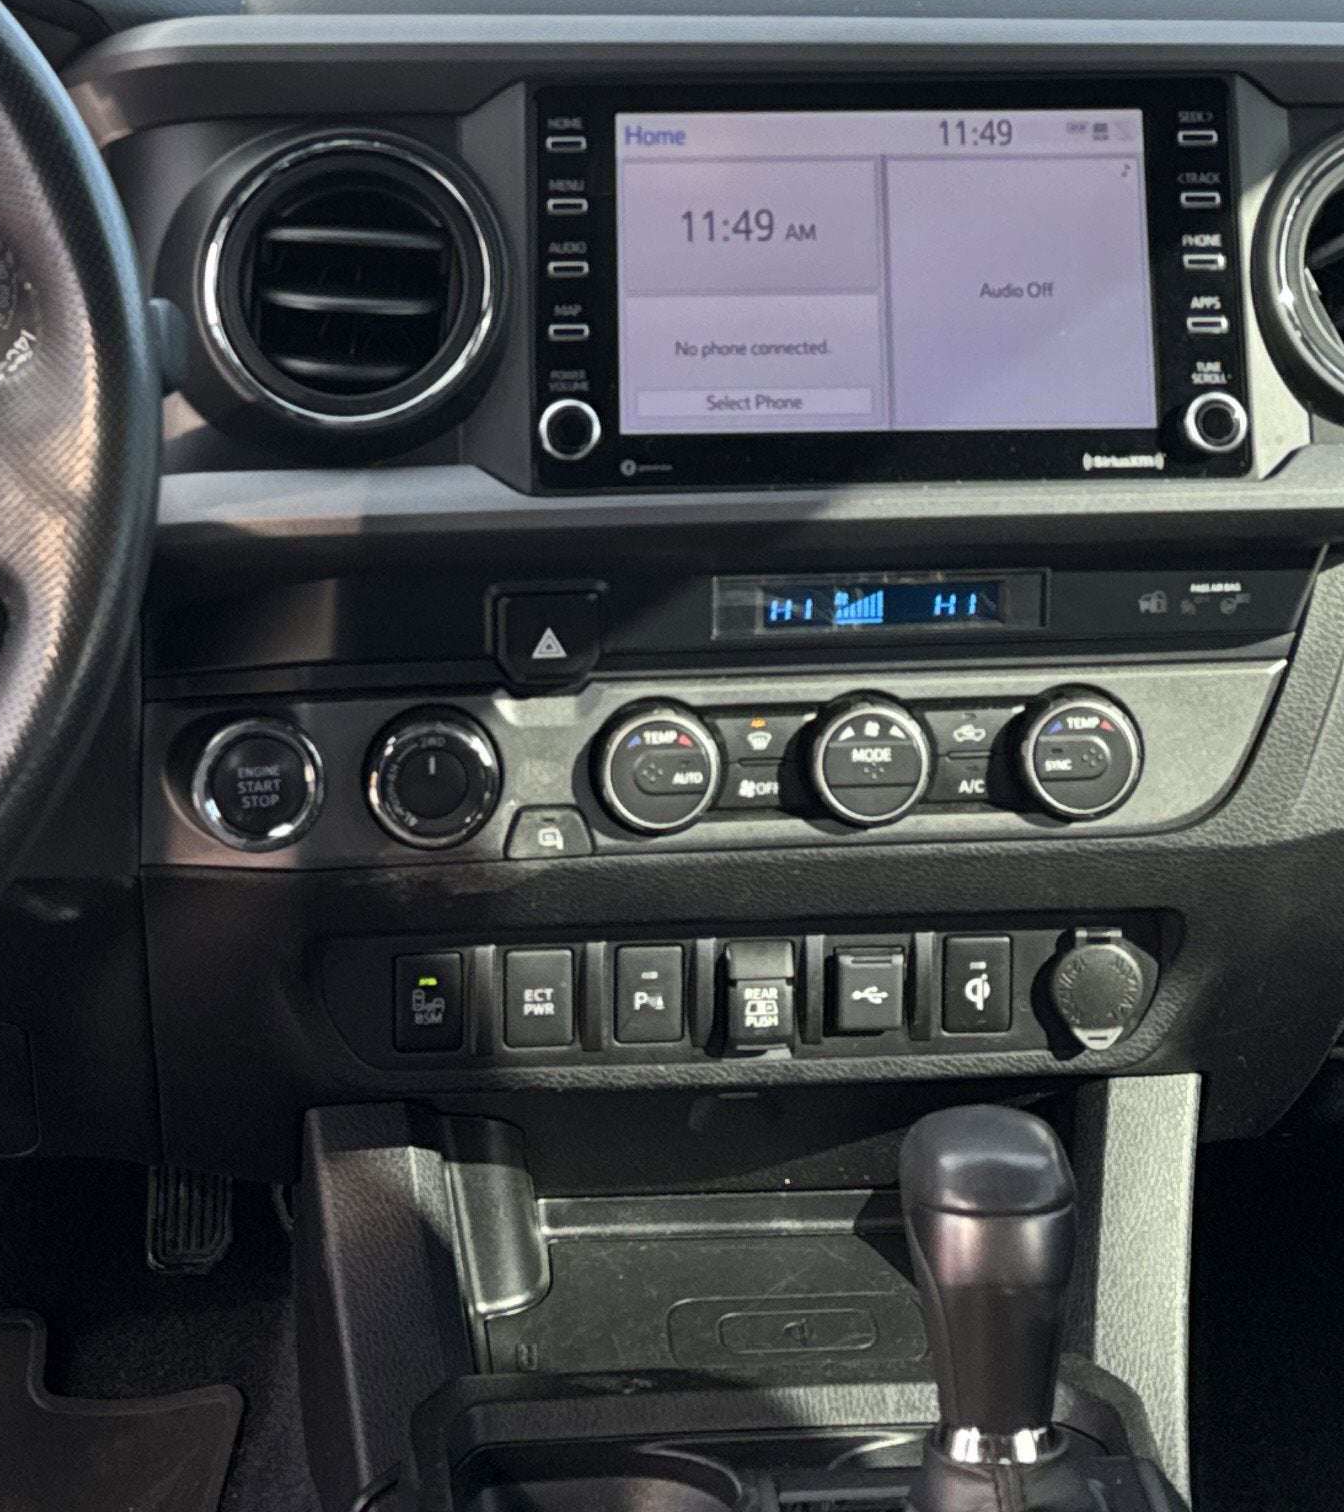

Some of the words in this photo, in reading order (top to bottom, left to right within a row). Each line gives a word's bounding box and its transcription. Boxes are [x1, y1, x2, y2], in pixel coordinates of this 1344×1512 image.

[624, 125, 687, 146] Home
[938, 118, 1014, 147] 11:49
[548, 178, 585, 192] MENU
[680, 208, 775, 243] 11:49
[785, 222, 818, 242] AM
[548, 241, 587, 255] AUDIO
[1181, 233, 1222, 248] PHONE
[978, 282, 1025, 299] Audio
[1026, 281, 1055, 298] Off
[553, 304, 582, 317] MAP
[1190, 296, 1222, 310] APPS
[674, 341, 697, 356] No
[702, 341, 747, 358] phone
[751, 340, 831, 355] connected.
[1191, 373, 1227, 385] SCROLL
[706, 395, 751, 411] Select
[755, 394, 803, 410] Phone
[769, 598, 813, 621] HI
[933, 592, 977, 616] HI
[1066, 716, 1101, 729] TEMP
[643, 730, 678, 745] TEMP
[851, 747, 892, 763] MODE
[236, 764, 281, 779] ENGINE
[1044, 759, 1073, 772] SYNC
[672, 771, 704, 785] AUTO
[236, 778, 282, 794] START
[959, 779, 986, 794] A/C
[241, 794, 280, 809] STOP
[523, 988, 554, 1002] ECT
[744, 987, 778, 1001] REAR
[522, 1002, 556, 1016] PWR
[745, 1013, 779, 1027] PUSH
